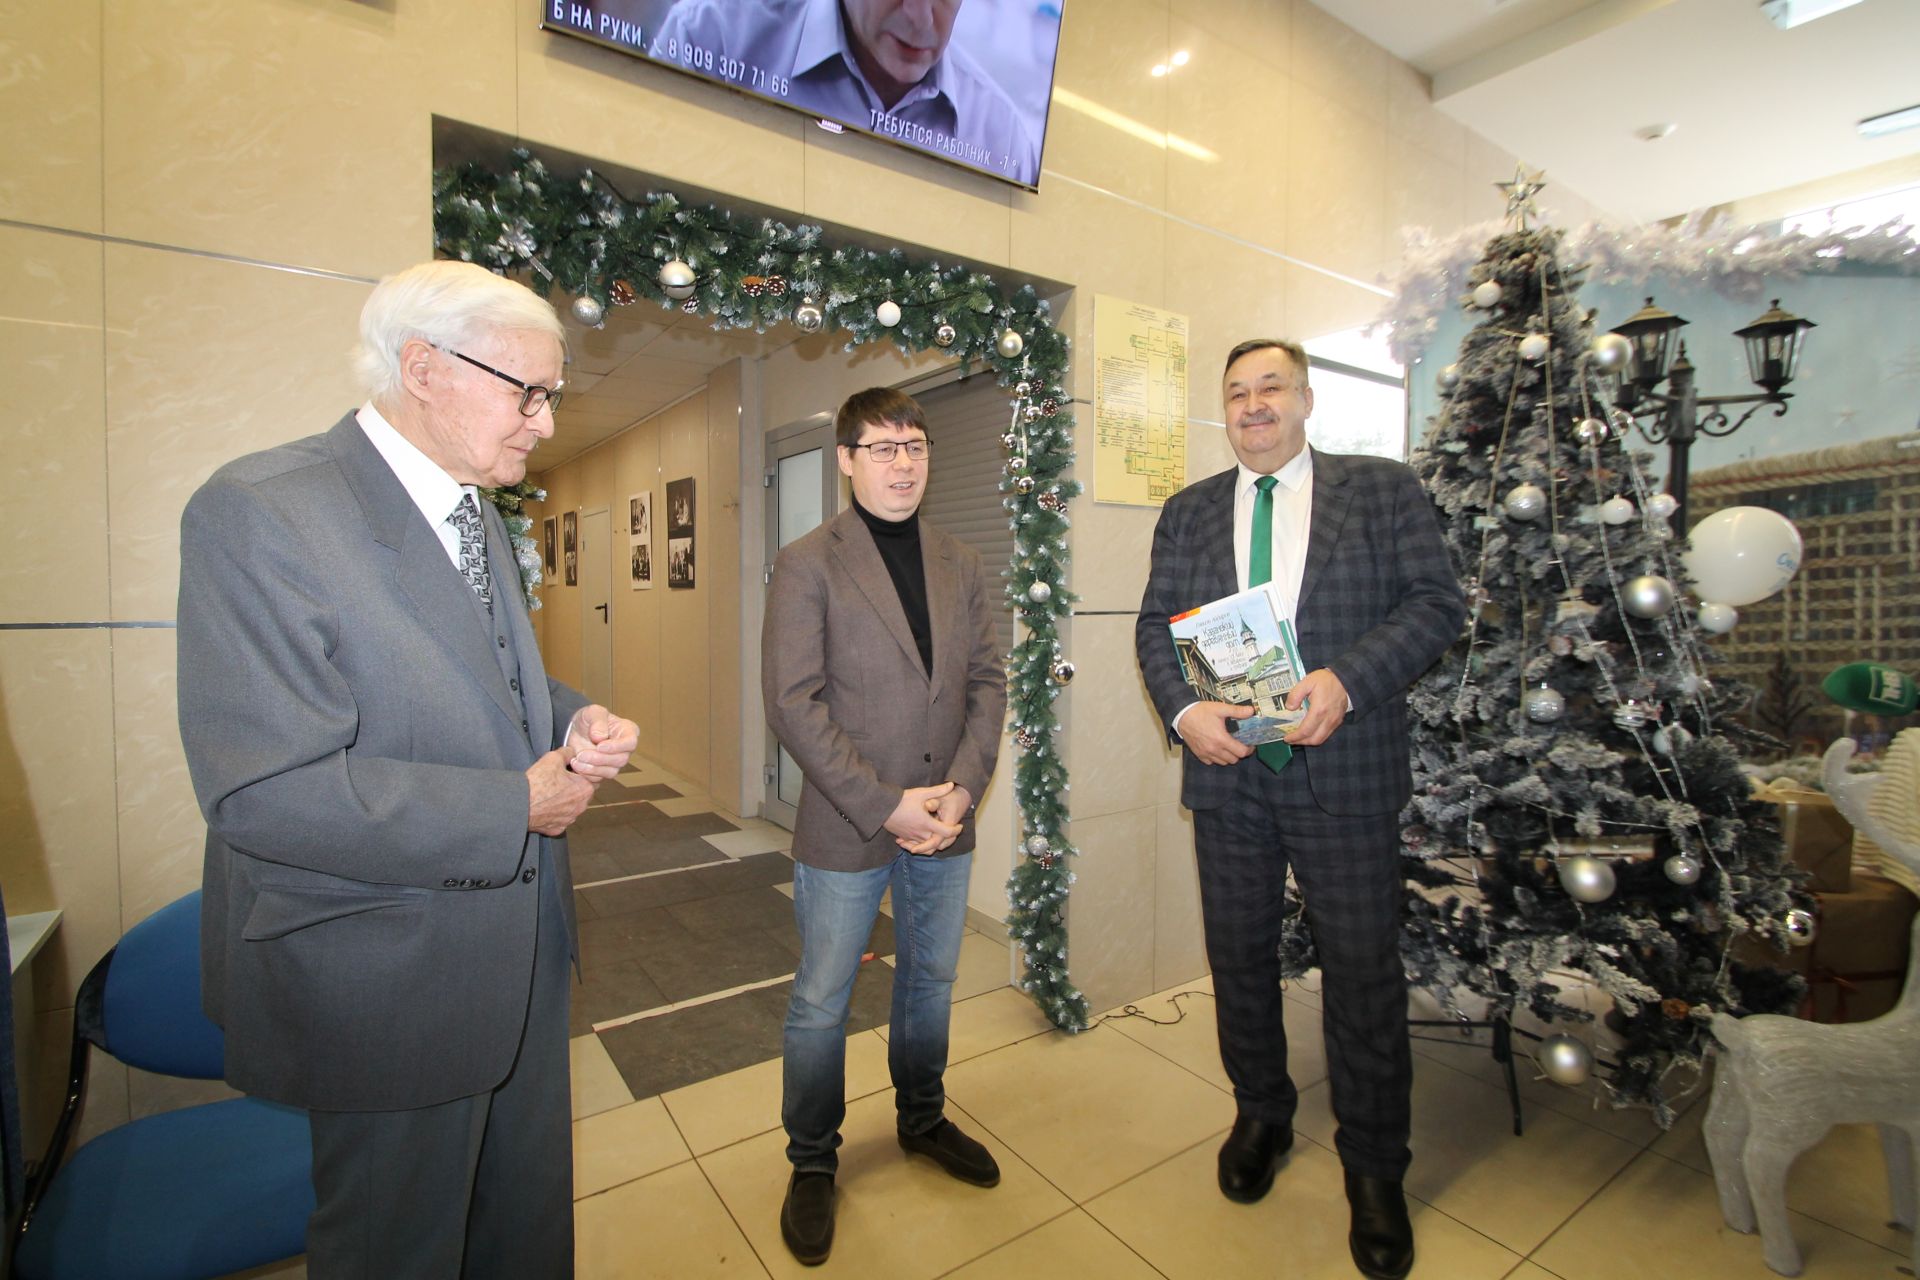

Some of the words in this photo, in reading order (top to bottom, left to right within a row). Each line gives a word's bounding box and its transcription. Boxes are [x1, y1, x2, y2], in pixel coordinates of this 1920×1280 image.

[571, 3, 593, 31] НА
[600, 13, 647, 49] РУКИ.
[668, 38, 677, 58] 8
[684, 43, 713, 71] 909
[719, 55, 746, 82] 307
[752, 66, 765, 88] 71
[771, 74, 789, 96] 66
[869, 108, 933, 146] ТРЕБУЕТСЯ
[936, 132, 992, 166] РАБОТНИК
